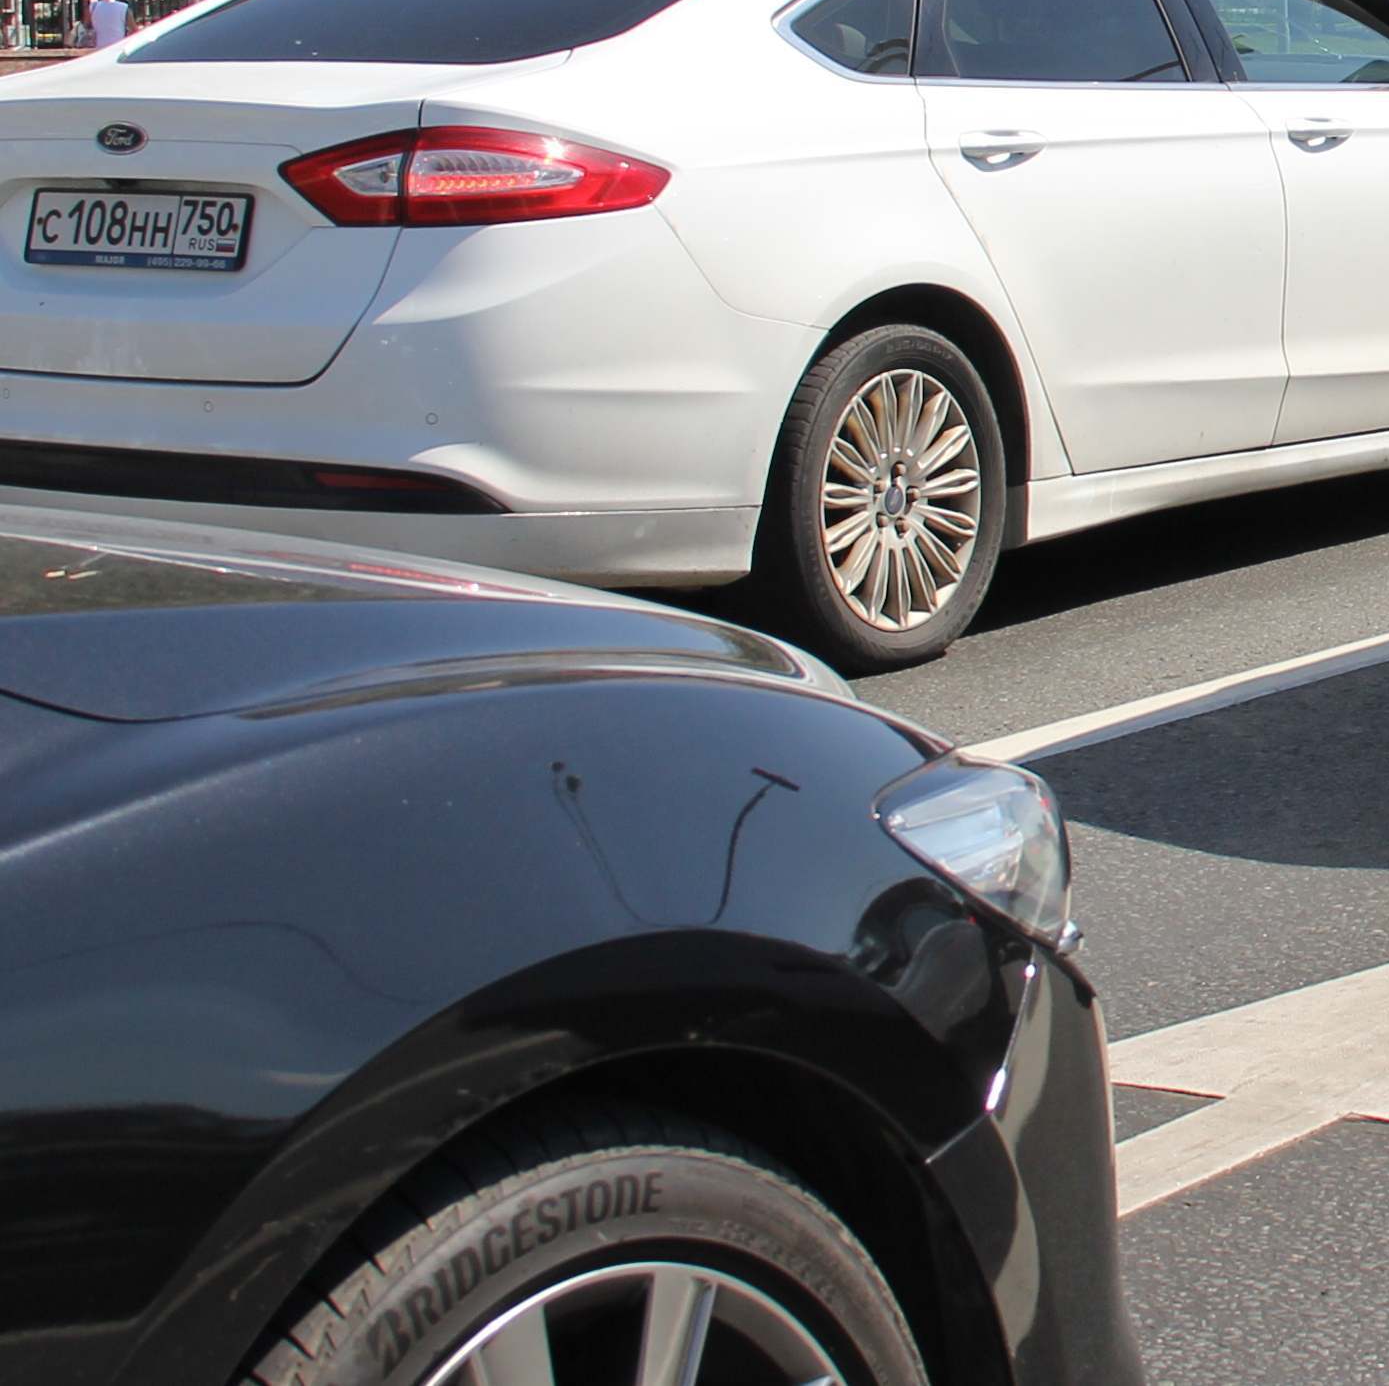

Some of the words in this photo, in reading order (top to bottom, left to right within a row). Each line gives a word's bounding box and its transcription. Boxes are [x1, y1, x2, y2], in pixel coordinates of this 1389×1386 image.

[104, 127, 134, 146] Ford
[42, 199, 173, 249] С108НН
[181, 199, 234, 237] 750
[188, 237, 215, 252] RUS
[366, 1171, 663, 1382] BRIDGESTONE
